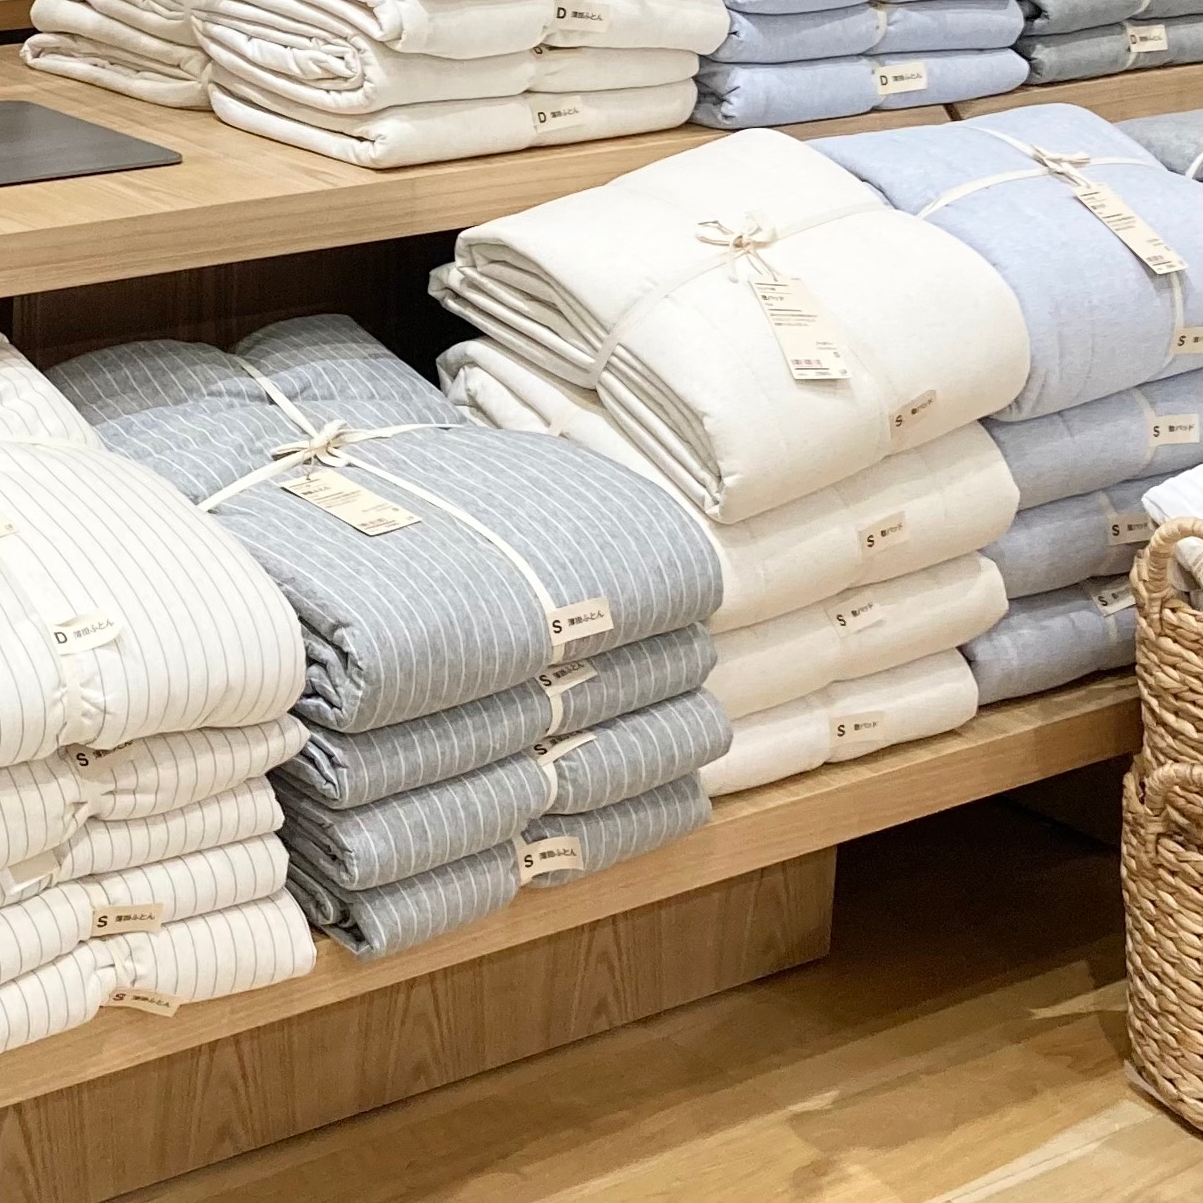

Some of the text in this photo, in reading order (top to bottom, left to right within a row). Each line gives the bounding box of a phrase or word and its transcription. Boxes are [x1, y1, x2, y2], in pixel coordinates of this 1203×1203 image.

[557, 7, 566, 19] D
[880, 76, 888, 86] D
[537, 112, 546, 124] D
[1177, 335, 1187, 347] S
[895, 415, 903, 427] S
[1153, 426, 1161, 437] S
[1112, 525, 1120, 536] S
[867, 535, 875, 547] S
[1098, 596, 1108, 607] S
[837, 614, 846, 626] S
[552, 619, 562, 634] S
[54, 631, 67, 644] D
[539, 675, 552, 687] S
[838, 724, 845, 737] S
[533, 743, 547, 755] S
[76, 752, 89, 767] S
[524, 855, 534, 868] S
[97, 915, 108, 927] S
[112, 993, 126, 1002] S
